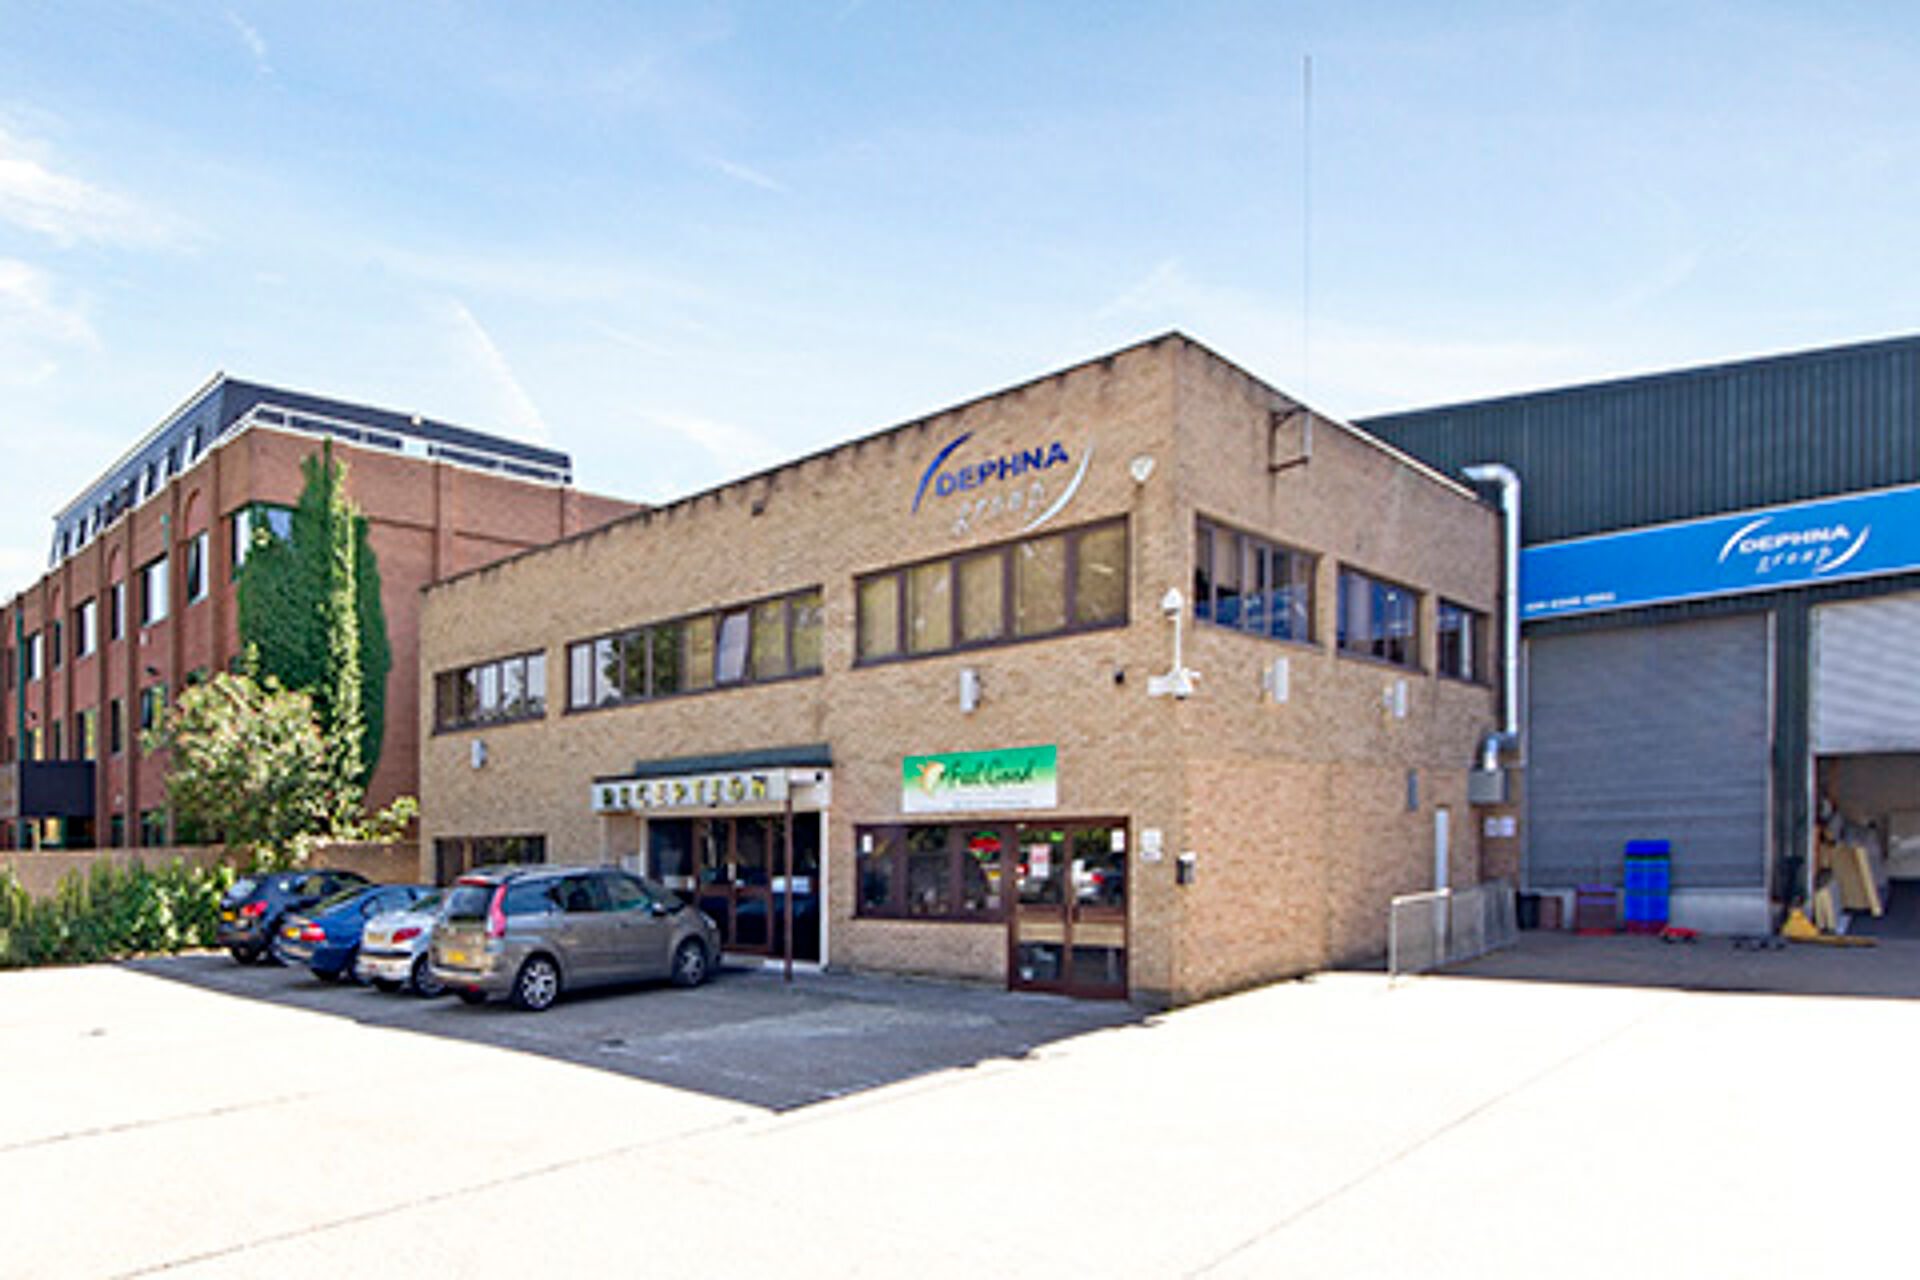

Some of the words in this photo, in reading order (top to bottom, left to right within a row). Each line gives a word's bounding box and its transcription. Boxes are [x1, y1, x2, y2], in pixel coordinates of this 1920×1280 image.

[935, 441, 1069, 497] DEPHNA
[1738, 523, 1851, 554] DEPHNA
[602, 774, 767, 807] RECEPTION
